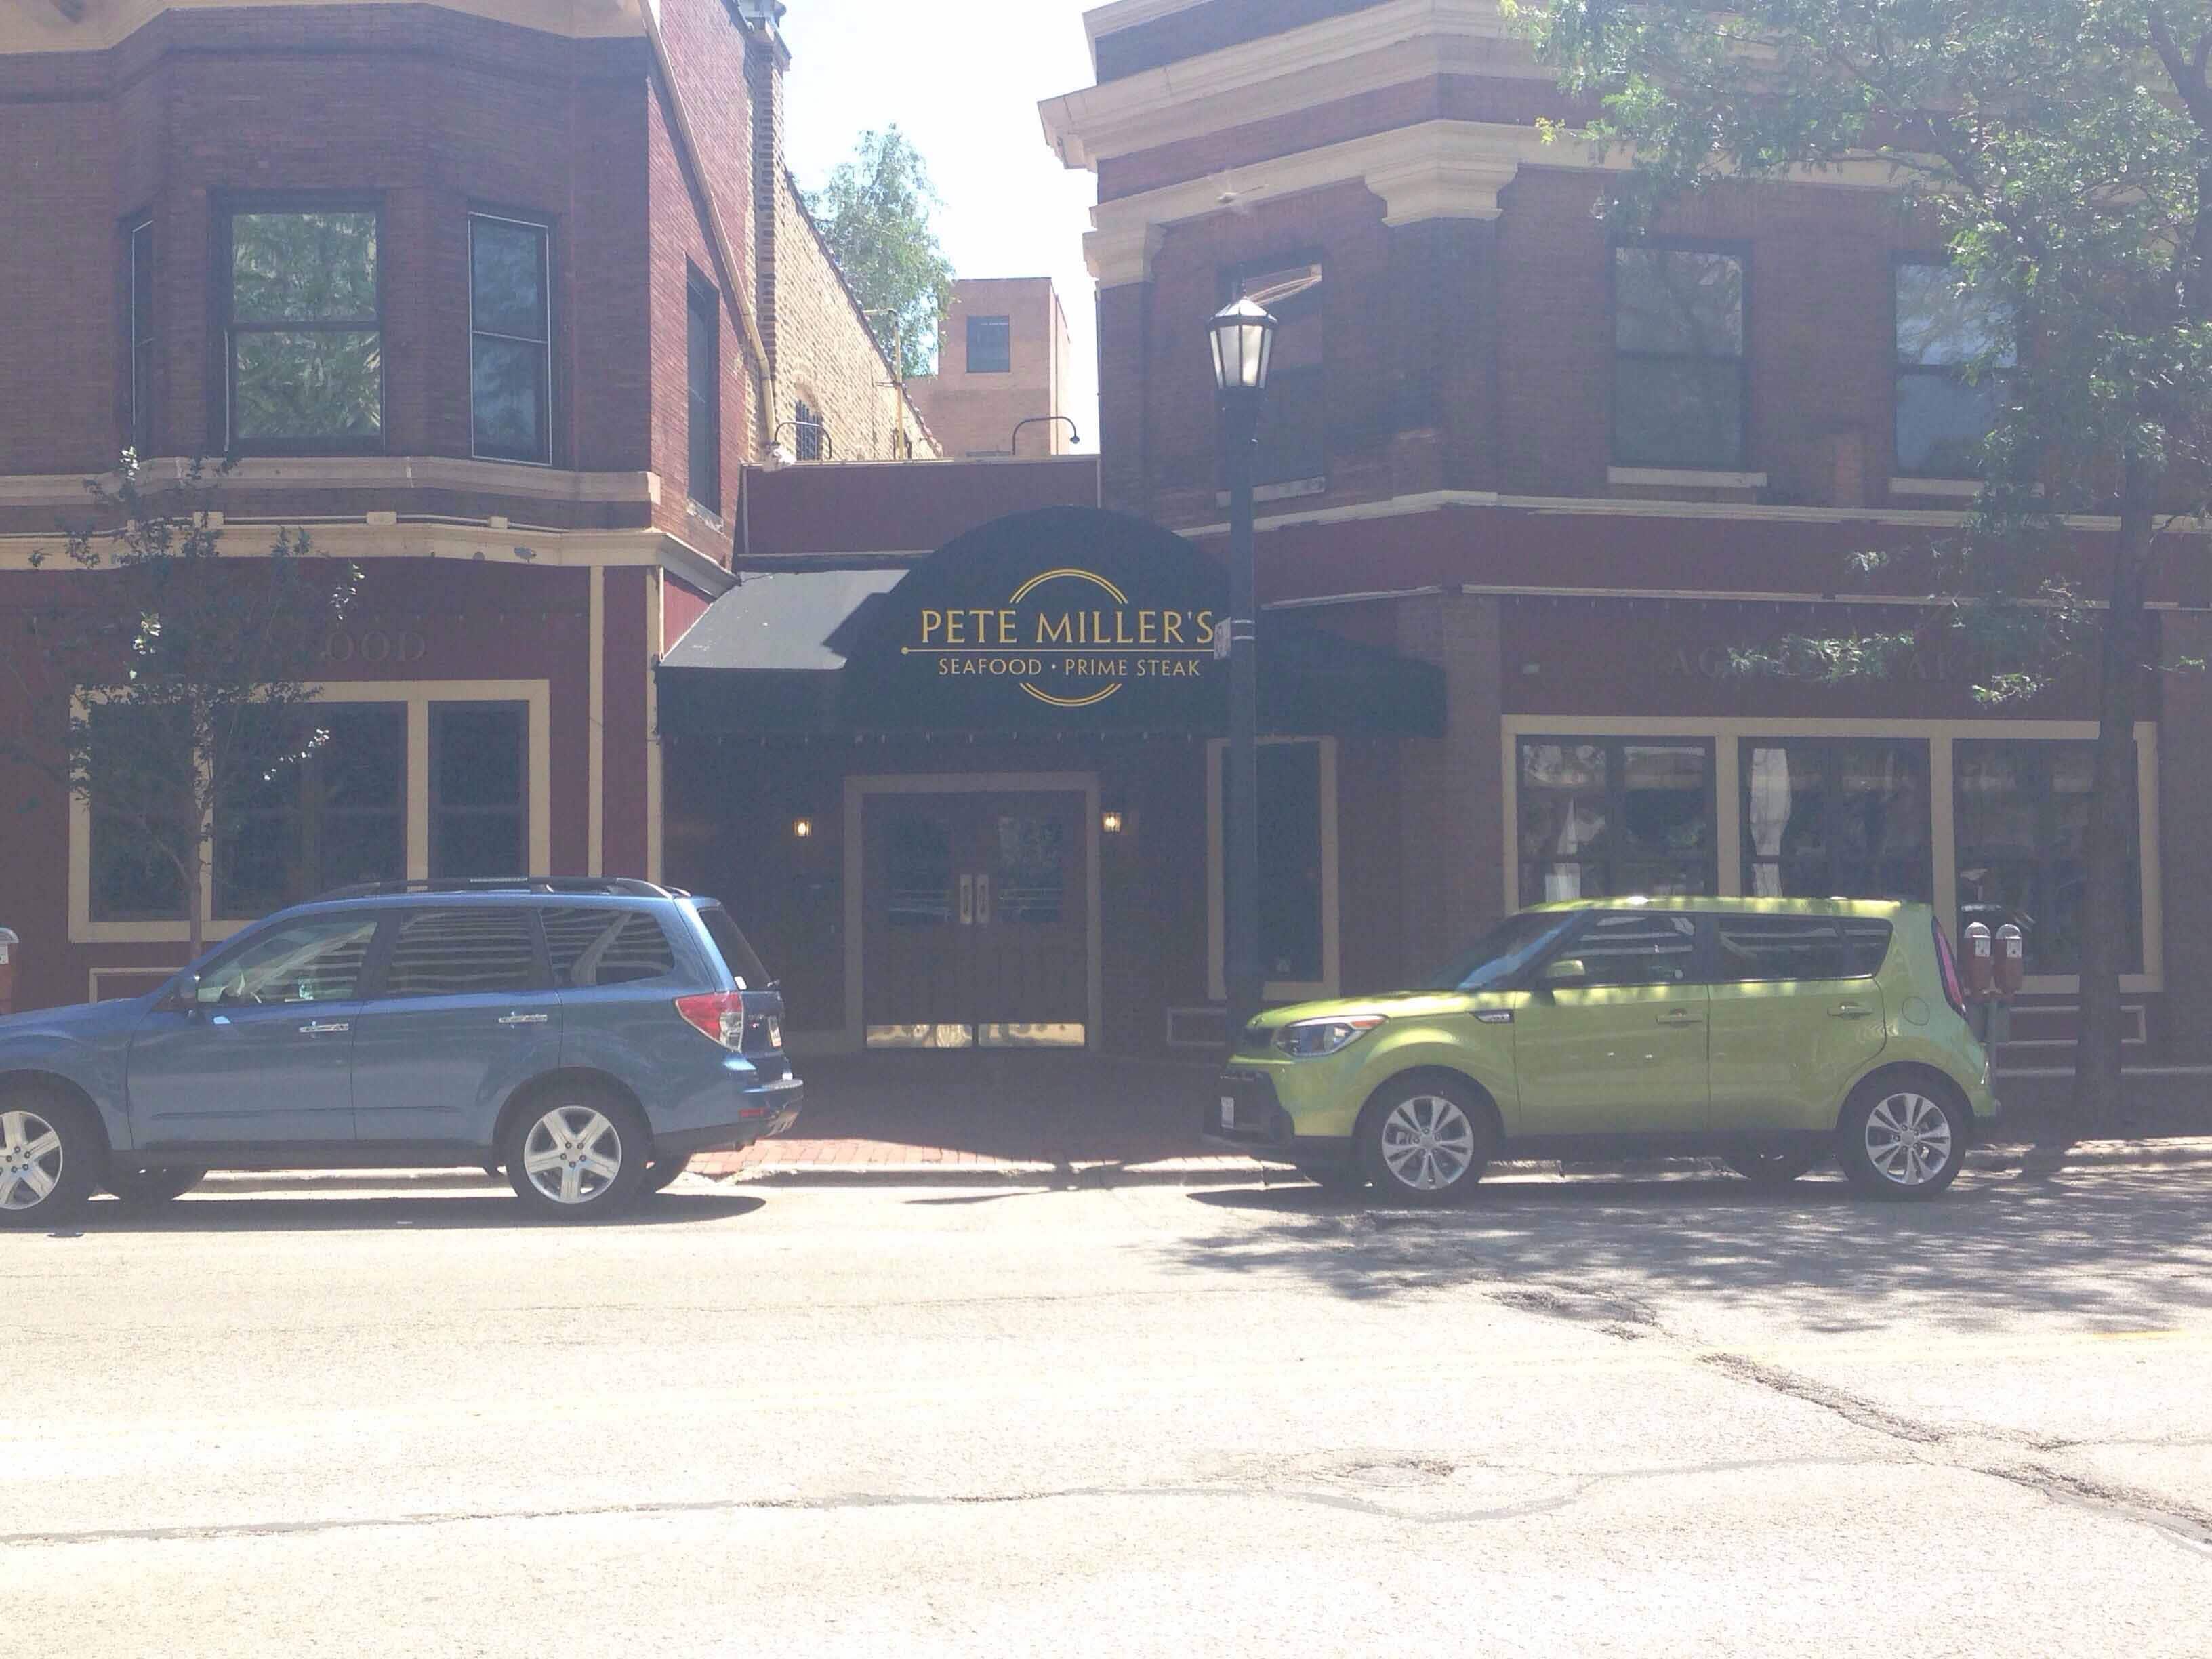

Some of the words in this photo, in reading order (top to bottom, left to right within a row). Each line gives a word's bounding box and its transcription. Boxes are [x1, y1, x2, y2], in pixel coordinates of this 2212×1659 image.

[921, 609, 1017, 644] PETE
[1036, 609, 1214, 644] MILLER'S
[938, 657, 1042, 676] SEAFOOD
[1065, 658, 1128, 676] PRIME
[1136, 659, 1202, 676] STEAK
